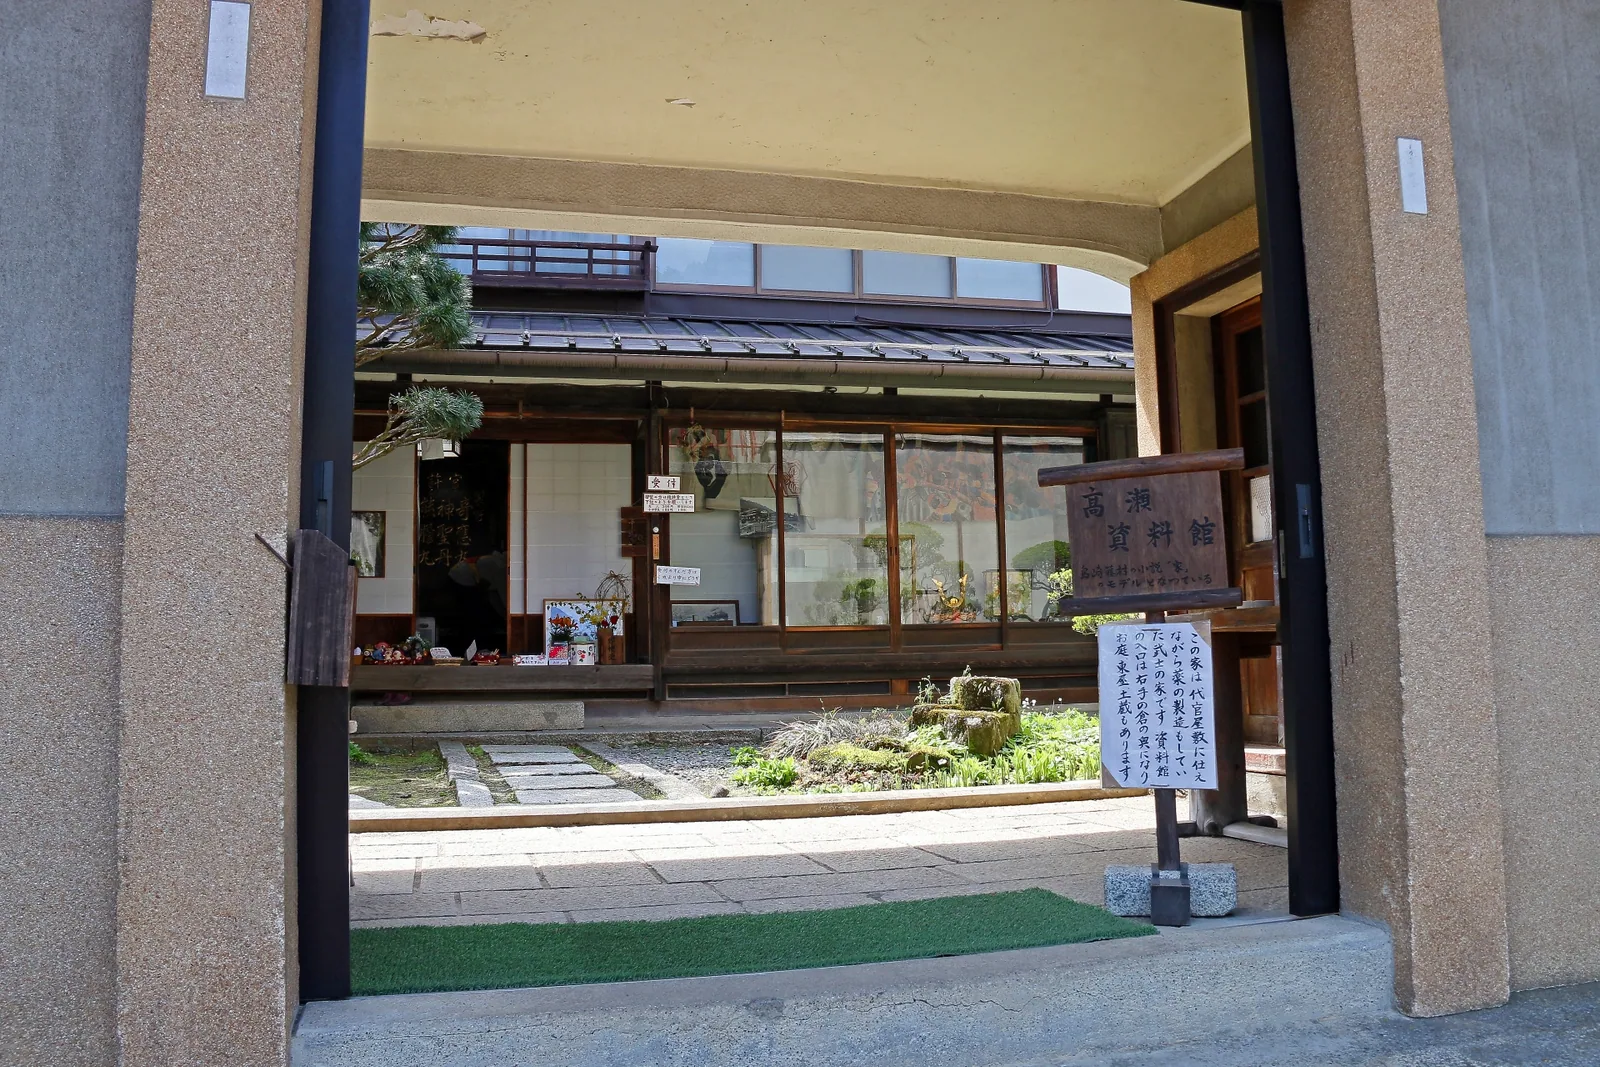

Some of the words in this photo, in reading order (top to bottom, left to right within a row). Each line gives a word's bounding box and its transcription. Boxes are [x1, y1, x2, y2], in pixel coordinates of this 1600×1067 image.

[651, 477, 677, 489] 受付
[1108, 516, 1216, 552] 資料館
